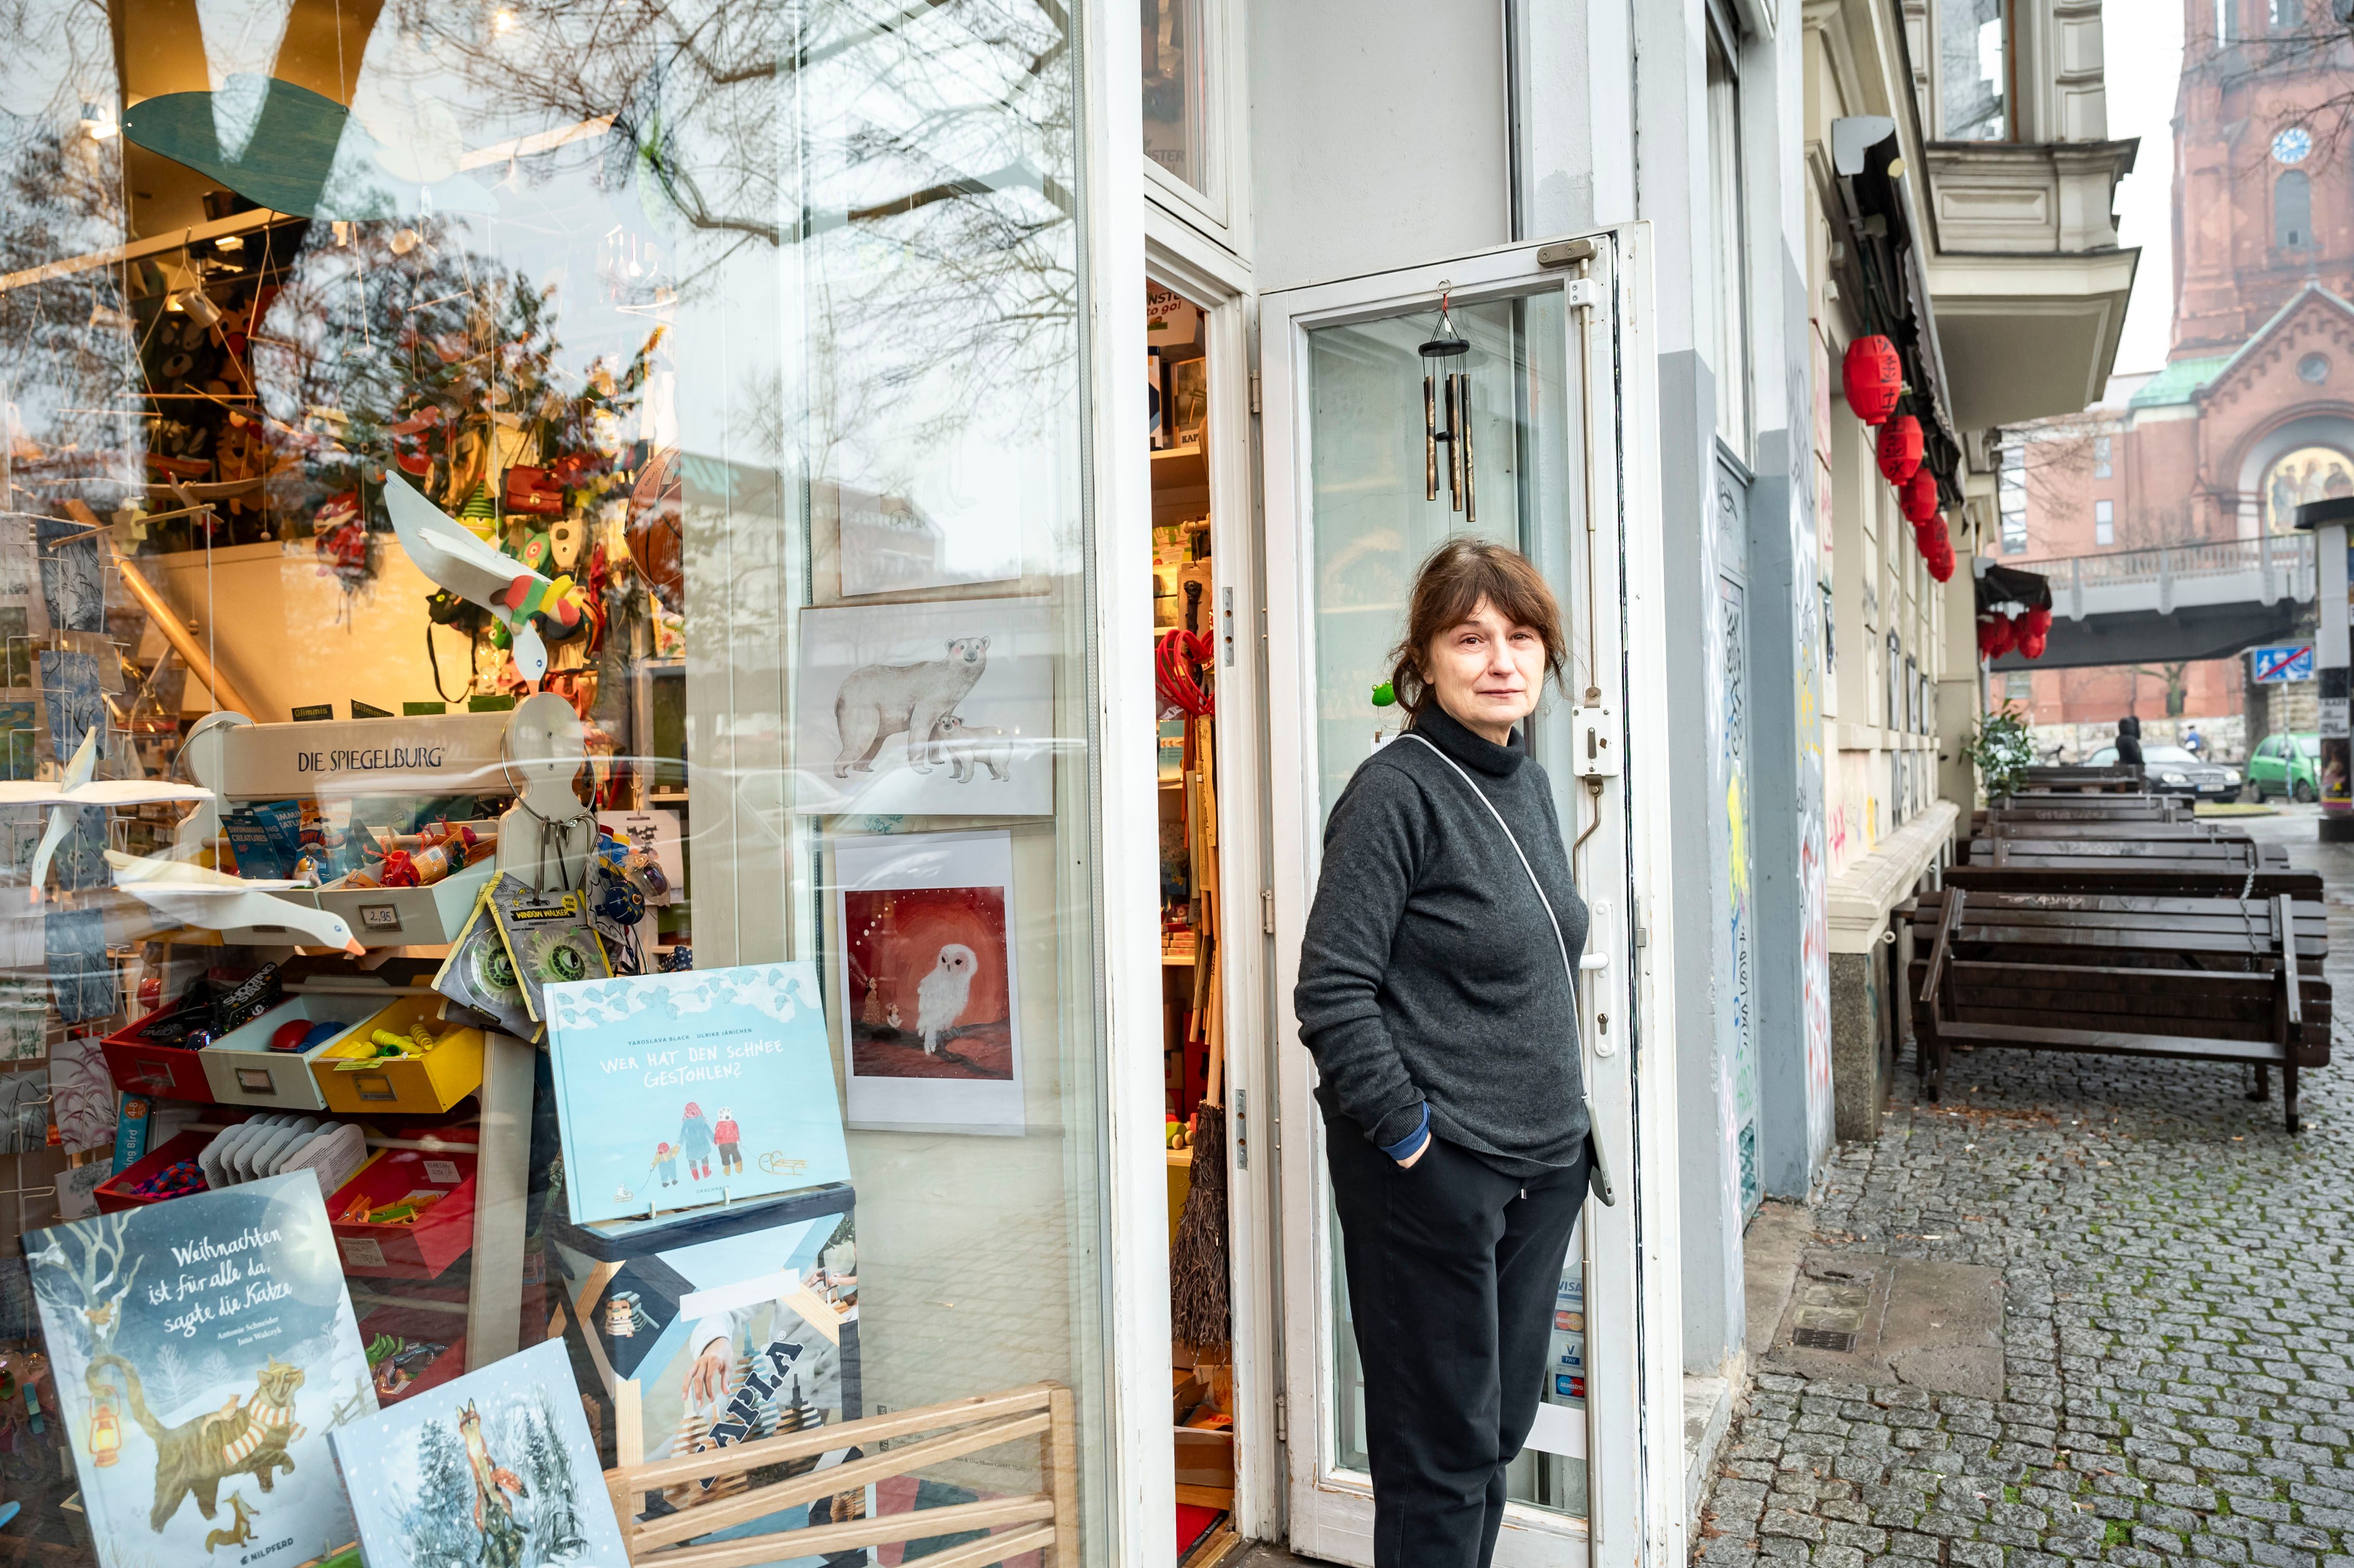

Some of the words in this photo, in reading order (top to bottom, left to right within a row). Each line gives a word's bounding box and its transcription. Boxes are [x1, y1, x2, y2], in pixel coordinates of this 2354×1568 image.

[1147, 292, 1180, 306] NST
[1161, 300, 1181, 315] go!
[294, 707, 328, 717] Glimmis
[298, 752, 326, 772] DIE
[330, 747, 441, 772] SPIEGELBURG
[370, 911, 391, 923] 2,95
[516, 910, 543, 919] WINDOW
[223, 963, 276, 1005] SHOOTING
[237, 980, 267, 1003] STAR
[628, 1037, 667, 1046] YAROSLAVA
[722, 1027, 752, 1036] JÄNICHEN
[600, 1056, 639, 1074] WER
[646, 1050, 679, 1067] HAT
[688, 1045, 717, 1063] DEN
[643, 1062, 742, 1088] GESTOHLEN?
[128, 1102, 139, 1117] 4-8
[127, 1129, 138, 1148] Bird
[124, 1151, 137, 1168] ing
[171, 1227, 282, 1267] Weihnachten
[148, 1279, 173, 1305] ist
[176, 1274, 207, 1301] für
[209, 1259, 241, 1287] alle
[1559, 1281, 1583, 1293] VISA
[164, 1302, 216, 1338] sagte
[219, 1296, 241, 1315] die
[243, 1281, 293, 1308] Katze
[217, 1326, 245, 1340] Antonie
[245, 1316, 279, 1331] Schneider
[237, 1336, 253, 1347] Jana
[253, 1326, 283, 1340] Walczyk
[1560, 1382, 1584, 1390] Maestro
[251, 1537, 294, 1561] NILPFERD
